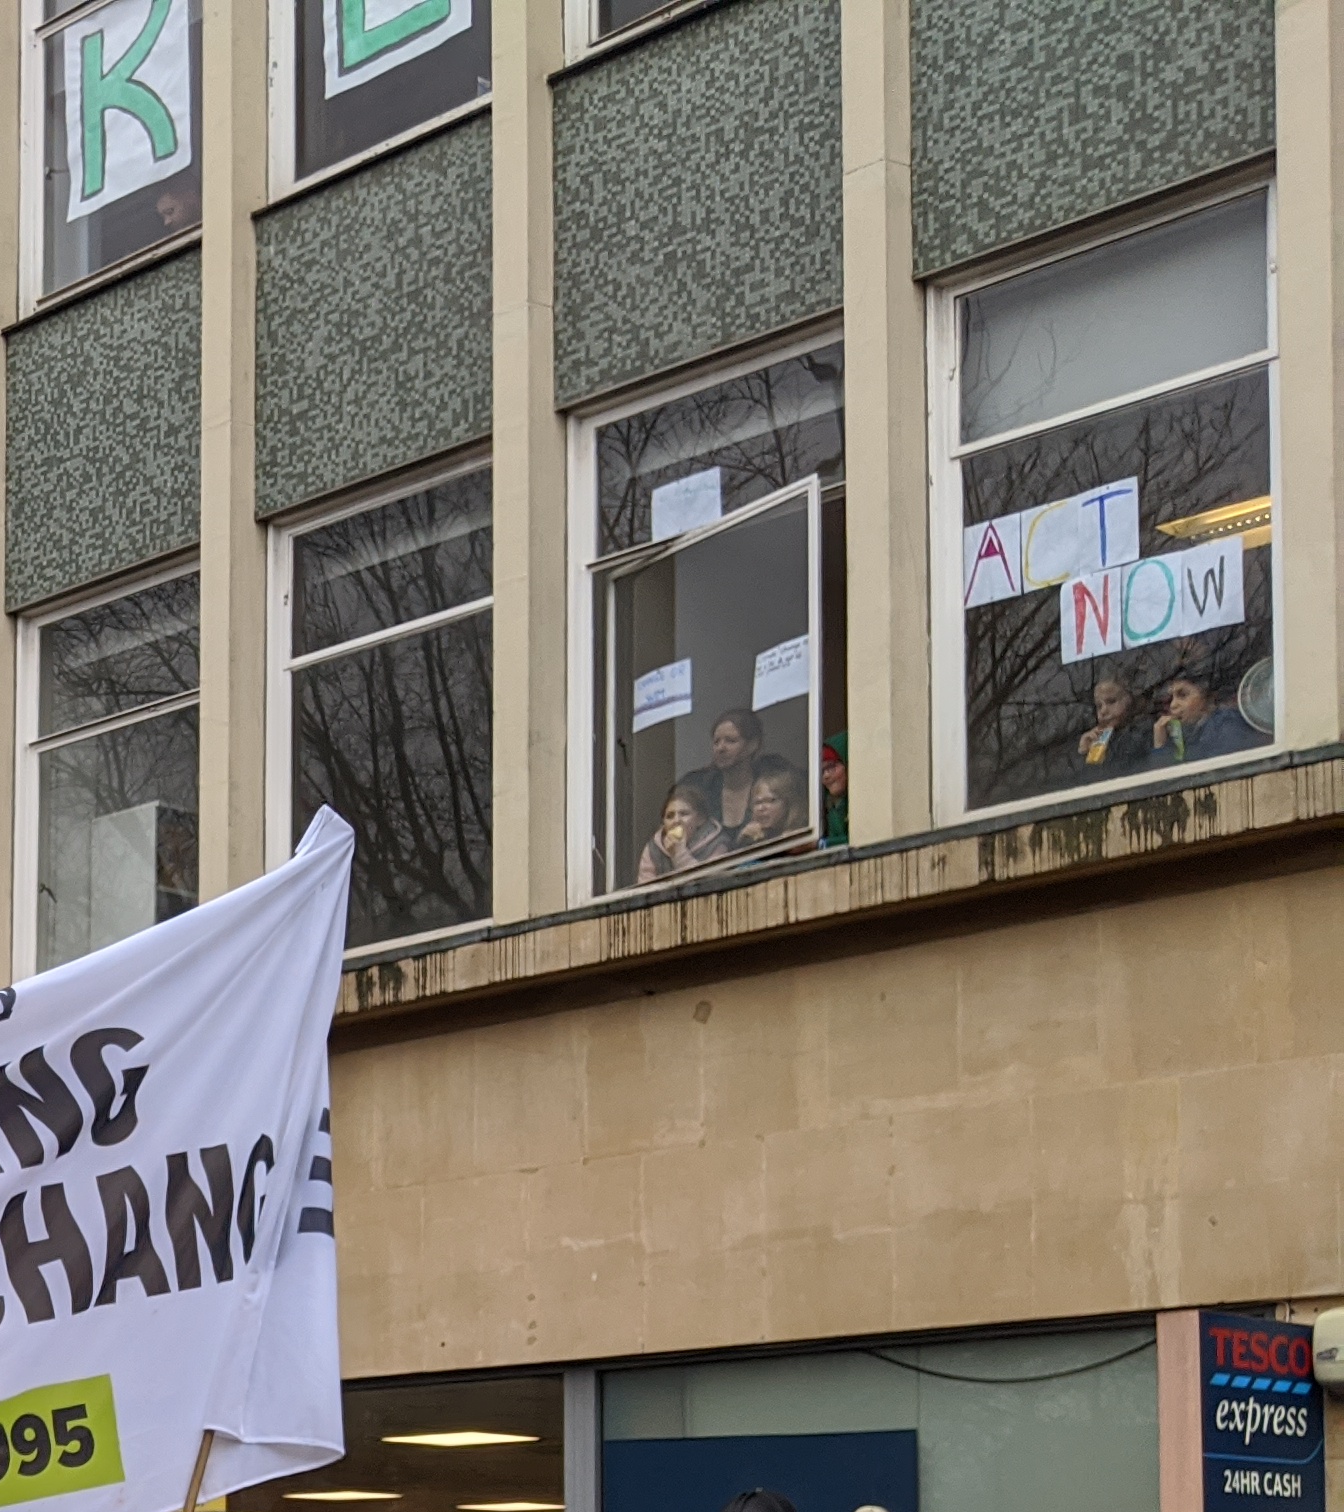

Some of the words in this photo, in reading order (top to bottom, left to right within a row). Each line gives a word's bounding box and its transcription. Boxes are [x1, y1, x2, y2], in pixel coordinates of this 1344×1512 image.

[964, 488, 1133, 606] ACT
[1072, 555, 1225, 655] NOW
[1209, 1327, 1311, 1377] TESCO
[1216, 1396, 1308, 1445] express
[1223, 1468, 1261, 1496] 24HR
[1264, 1472, 1302, 1498] CASH
